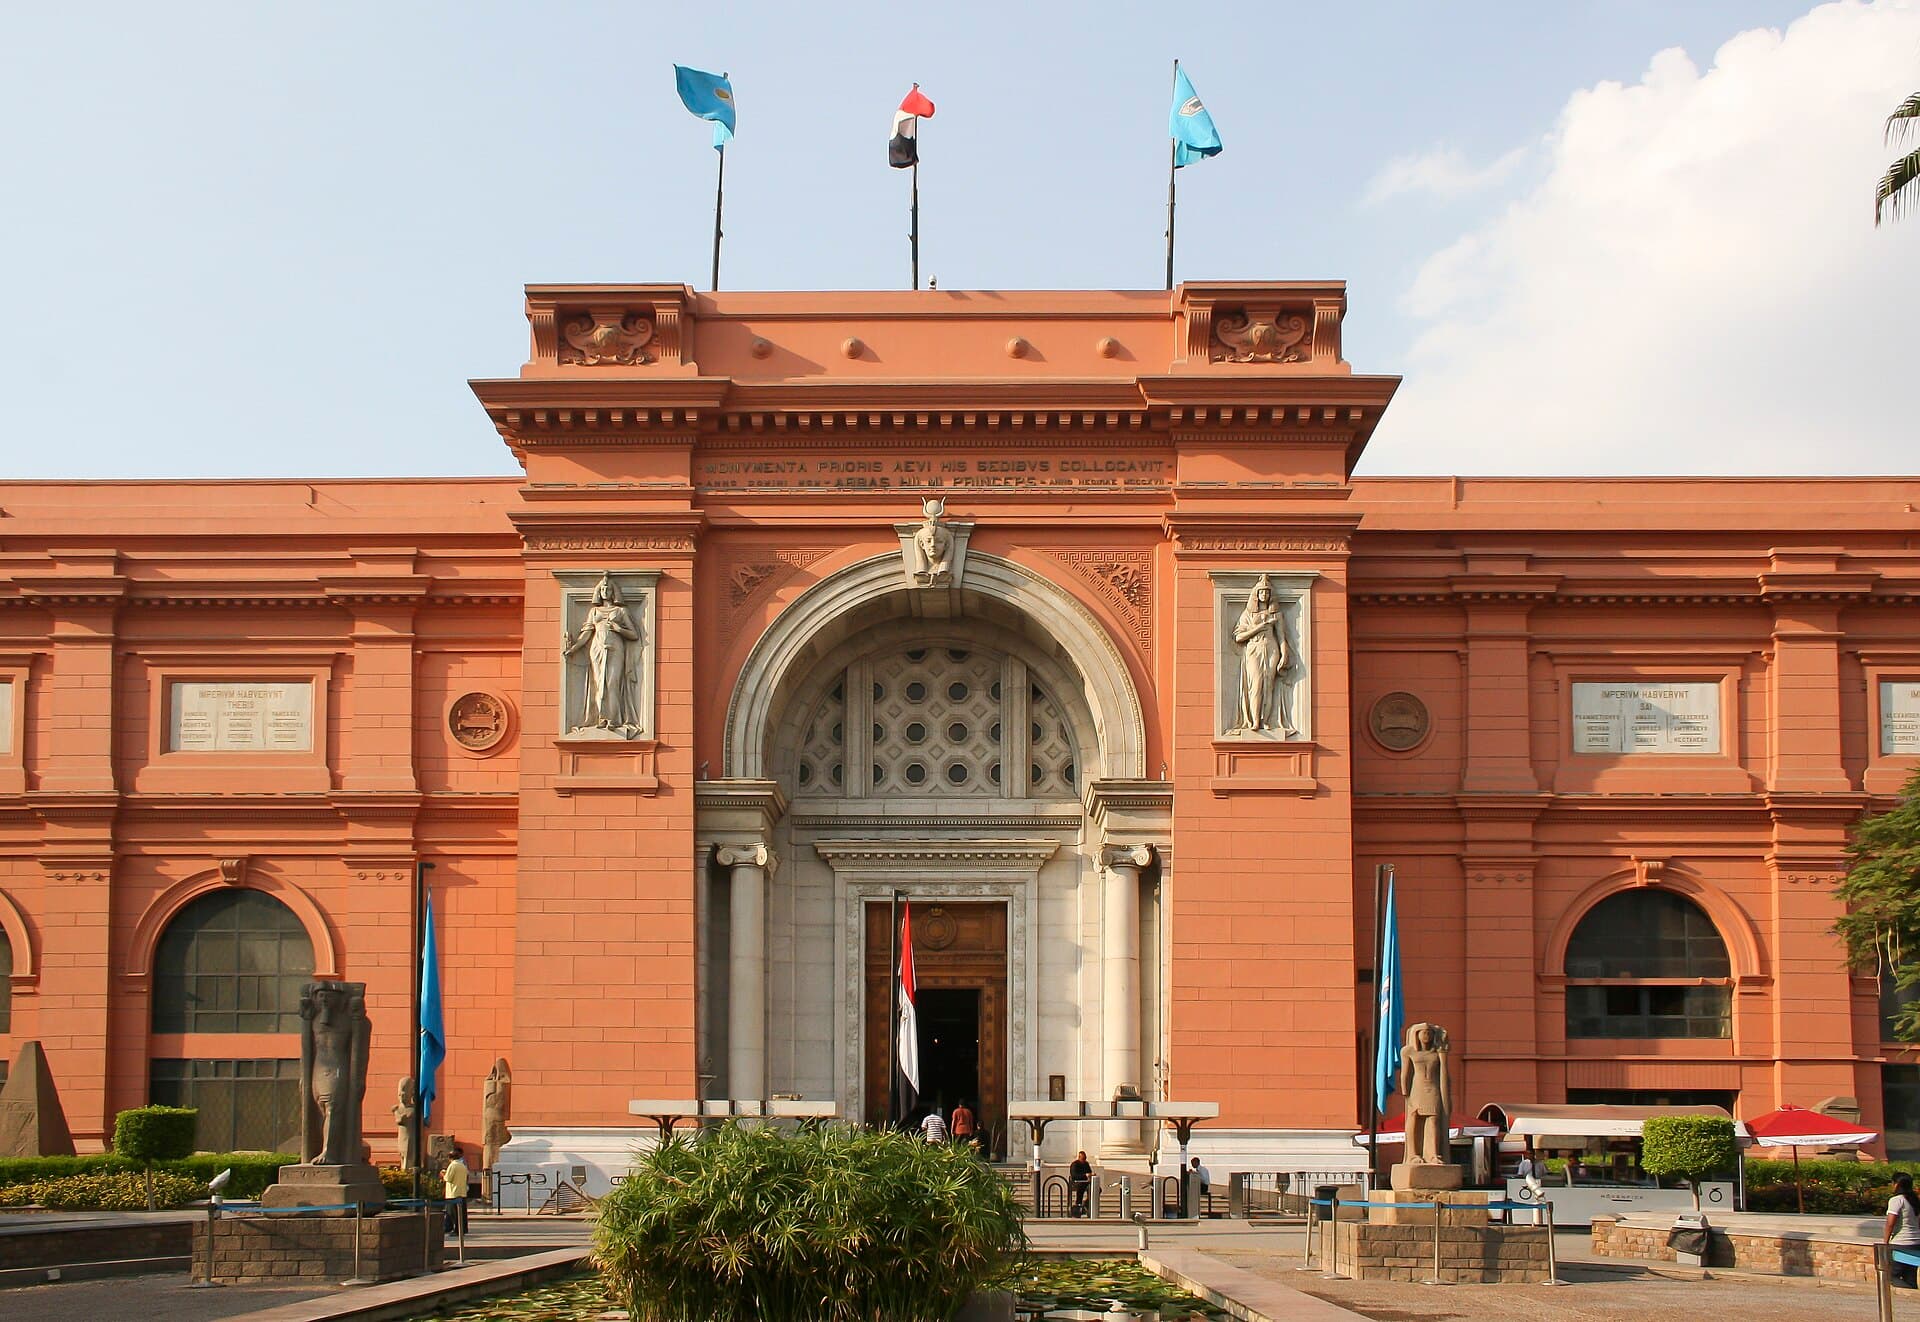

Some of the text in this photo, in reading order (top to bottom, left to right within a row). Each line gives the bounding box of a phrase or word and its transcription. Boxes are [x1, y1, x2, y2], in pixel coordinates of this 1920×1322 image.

[705, 460, 1164, 473] MONVMENTA PRIORIS AEVI HIS SEDIBVS COLLOCAVIT
[835, 477, 890, 487] ABBAS
[953, 477, 1036, 487] PRINCEPS
[1601, 690, 1689, 699] IMPERIVM HABVERVNT
